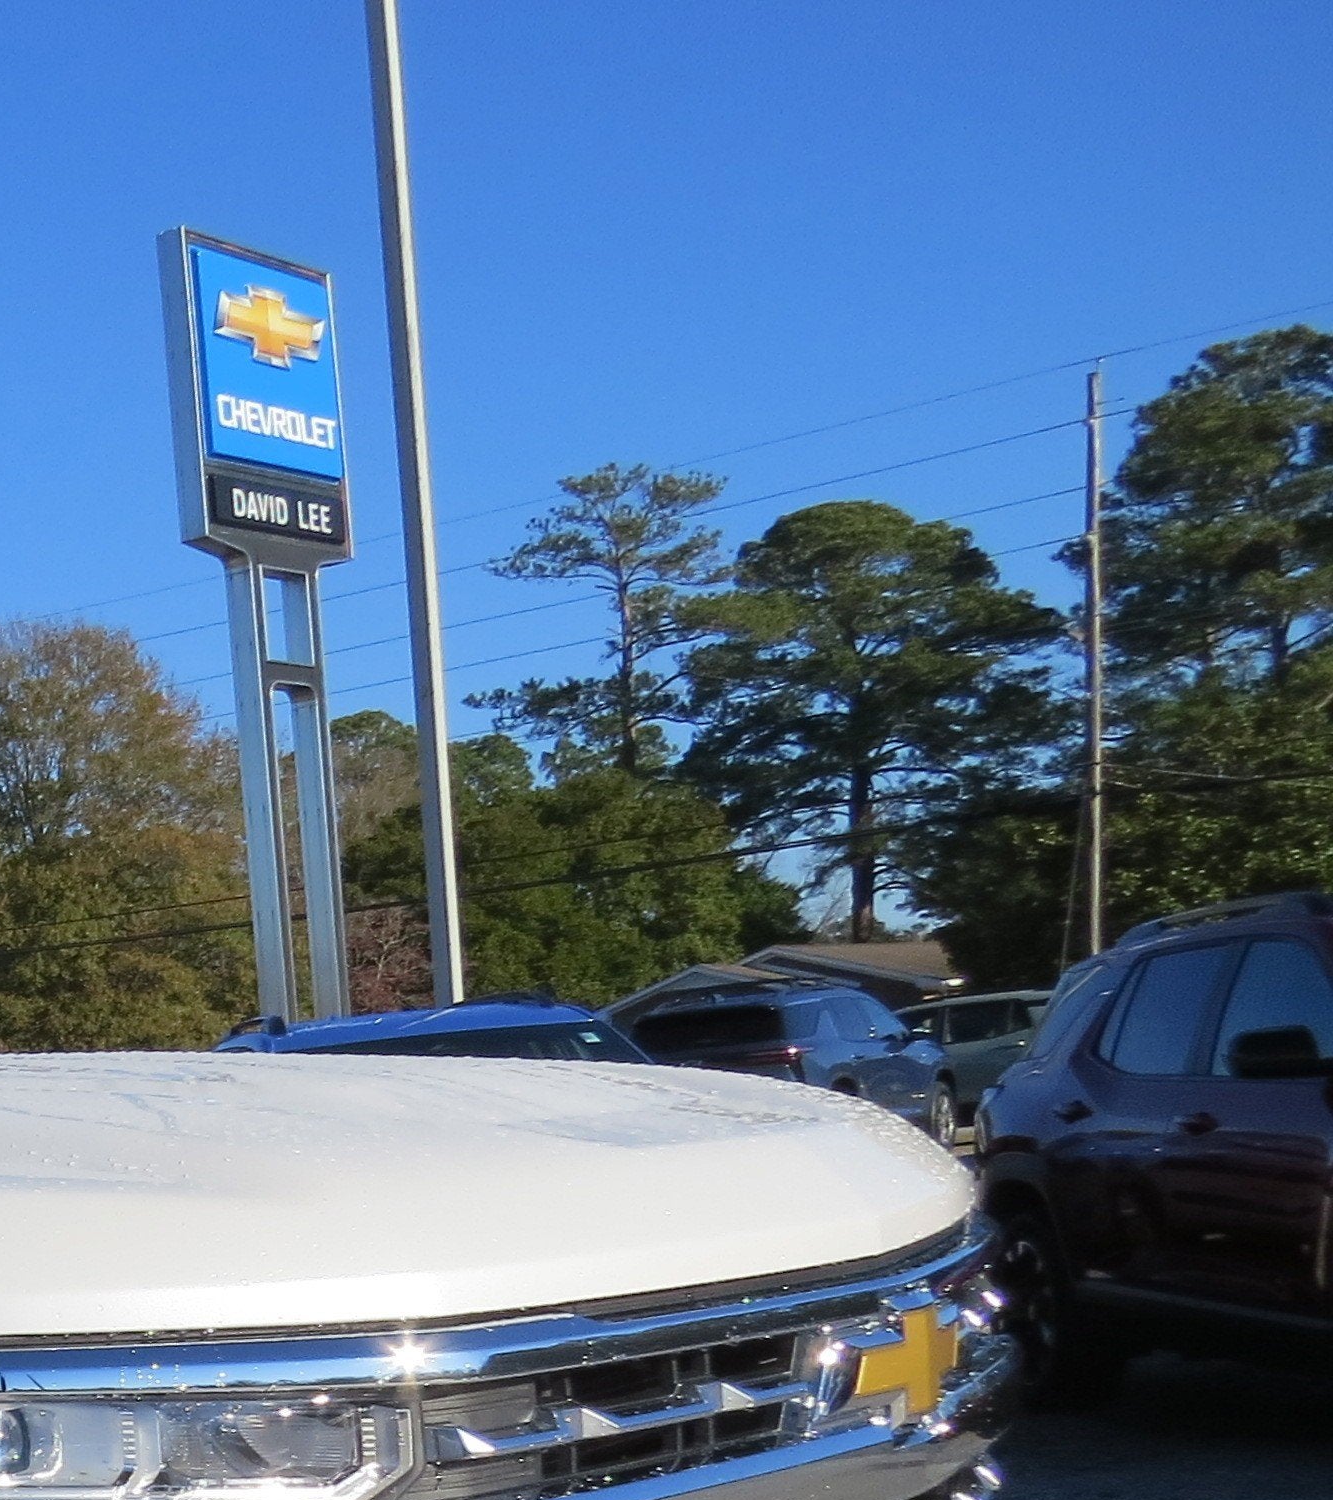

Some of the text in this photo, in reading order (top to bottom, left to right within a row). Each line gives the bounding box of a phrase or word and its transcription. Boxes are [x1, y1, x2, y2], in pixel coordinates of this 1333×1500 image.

[216, 394, 336, 450] CHEVROLET
[232, 487, 333, 534] DAVID LEE
